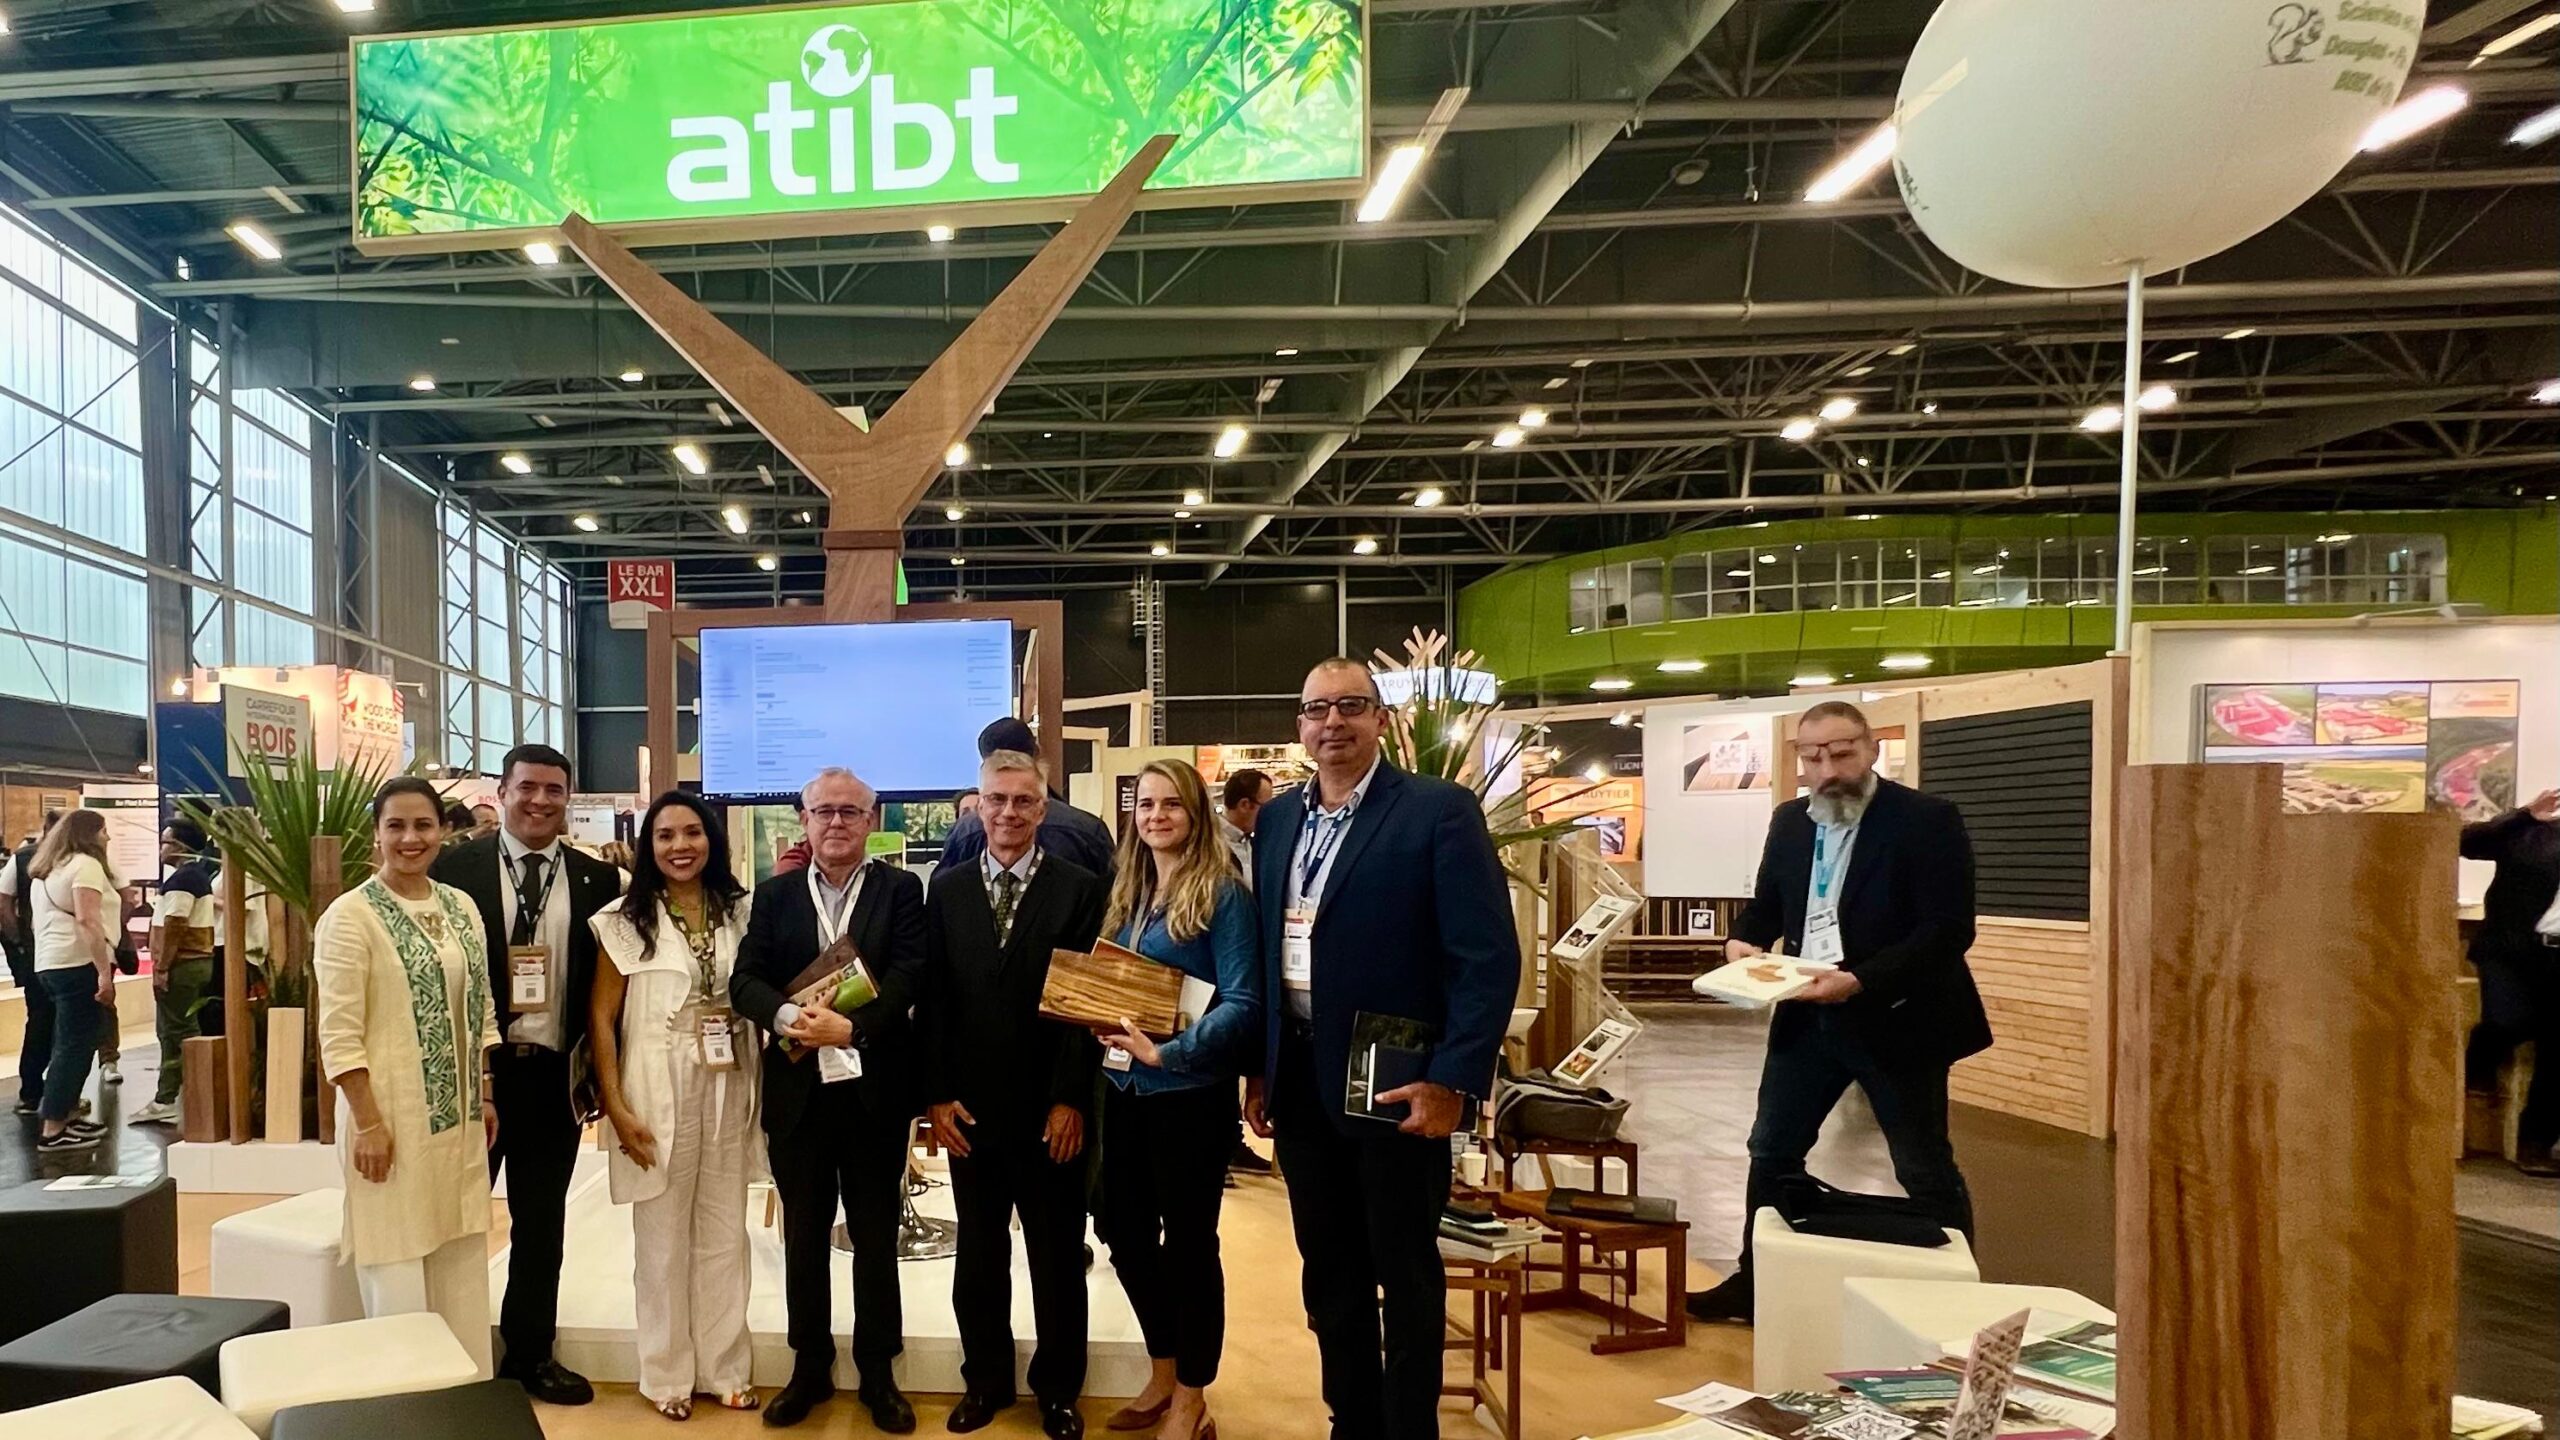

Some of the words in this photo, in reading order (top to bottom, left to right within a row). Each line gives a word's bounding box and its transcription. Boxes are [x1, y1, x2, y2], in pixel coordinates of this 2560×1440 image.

[666, 62, 1020, 202] atibt
[618, 564, 634, 576] LE
[637, 564, 664, 577] BAR
[619, 576, 664, 597] XXL
[247, 721, 297, 755] BOIS
